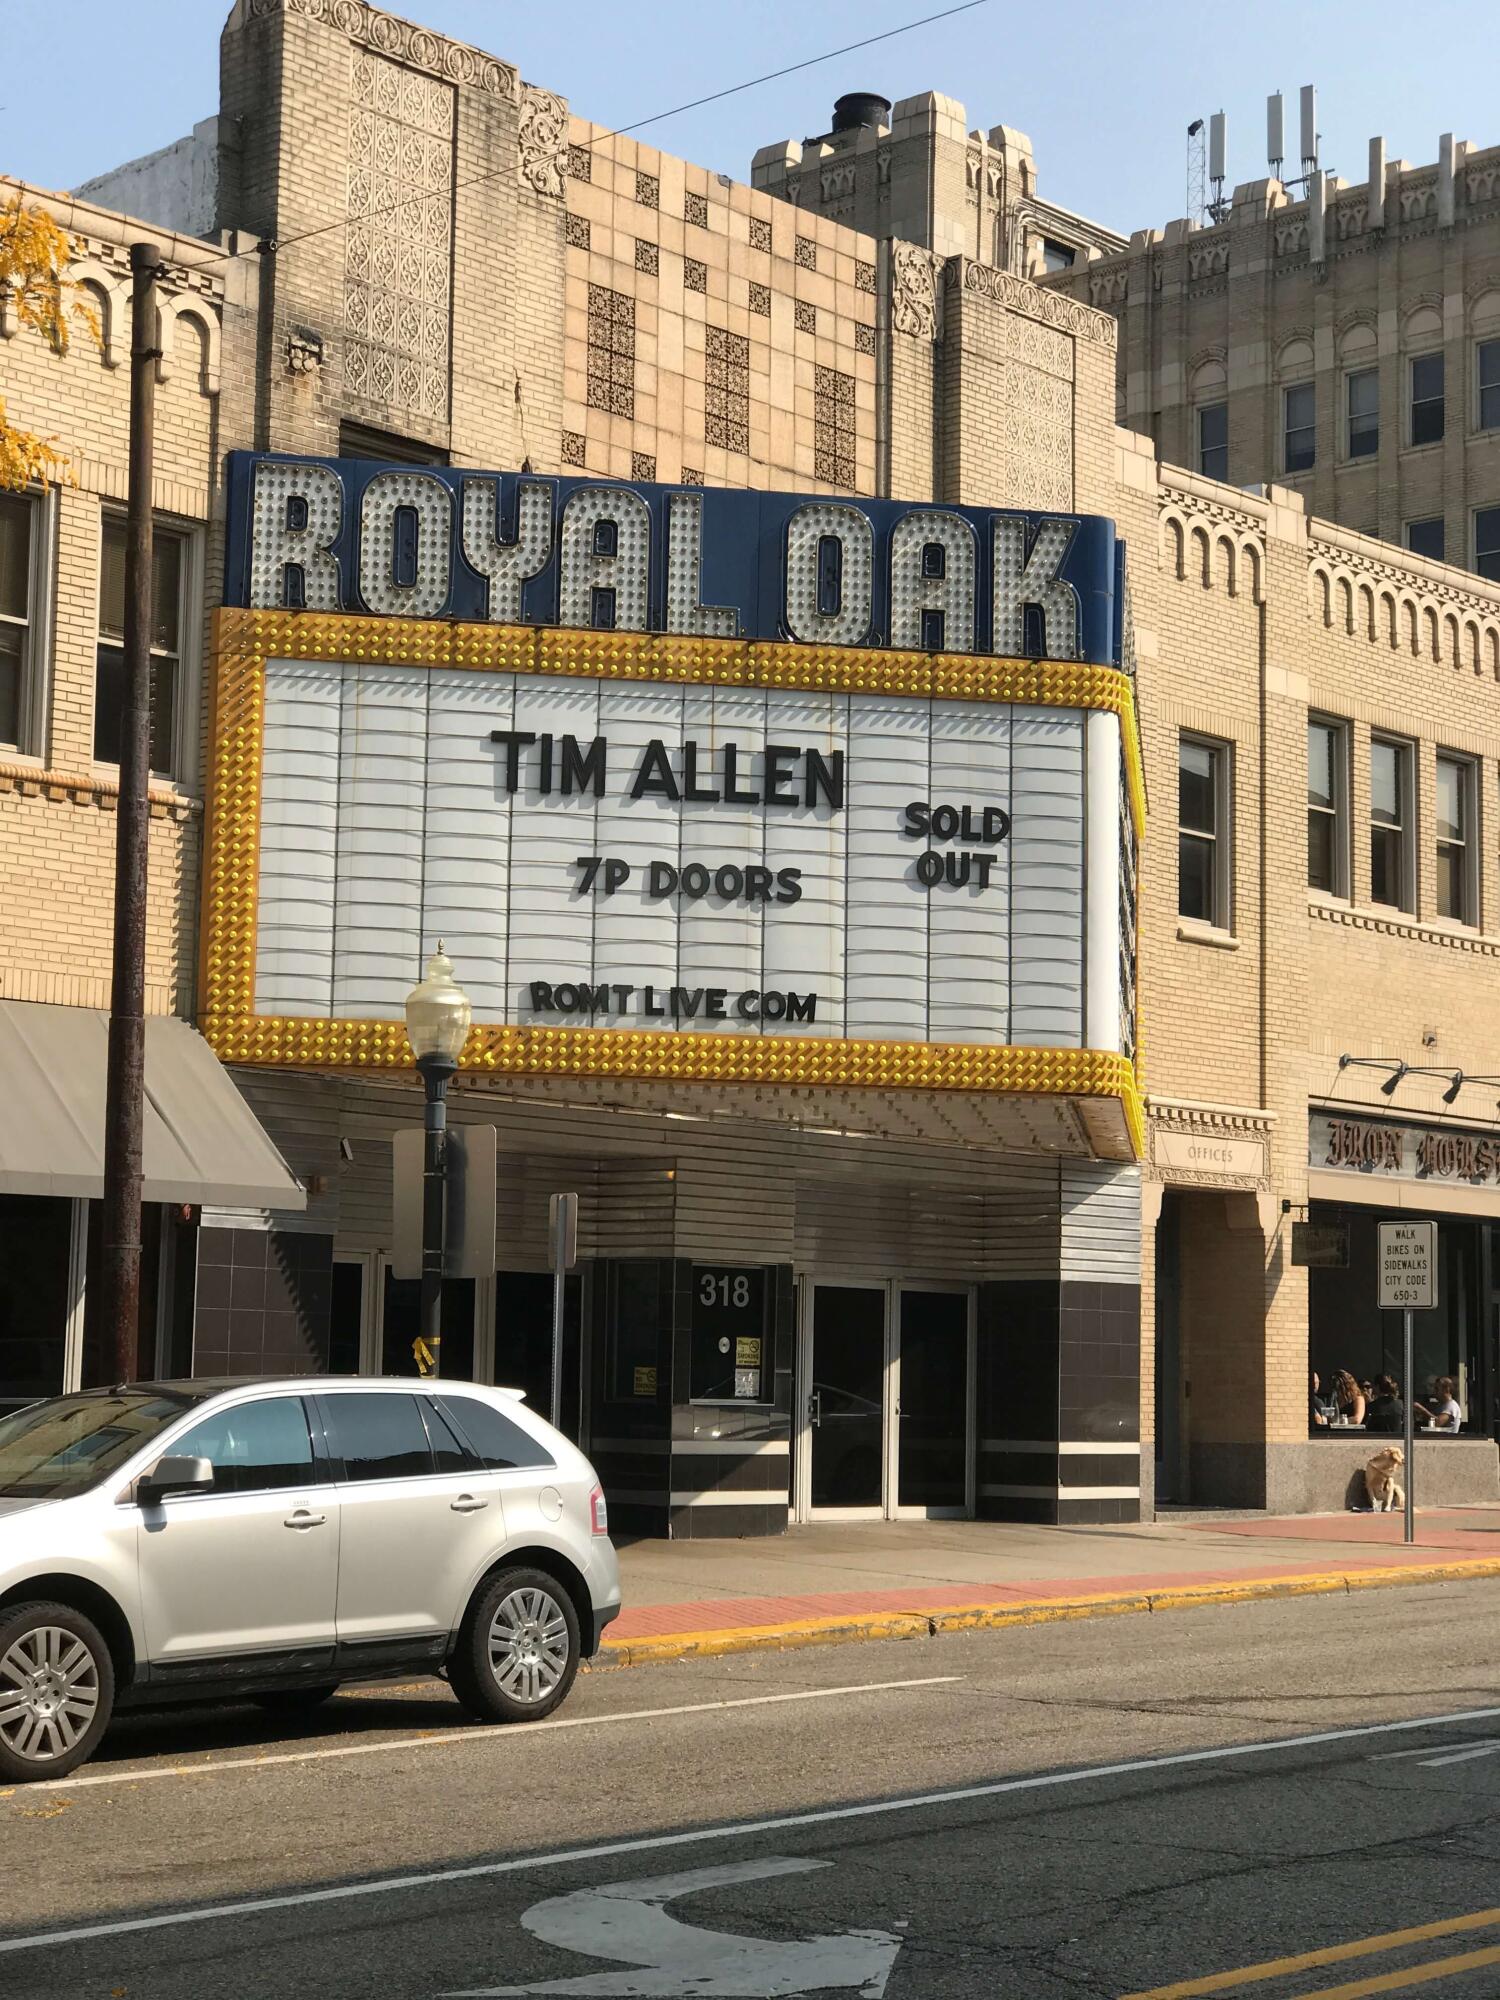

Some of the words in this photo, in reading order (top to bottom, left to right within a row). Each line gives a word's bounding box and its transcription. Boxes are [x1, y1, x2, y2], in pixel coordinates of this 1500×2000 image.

[249, 461, 738, 637] ROYAL
[783, 502, 1083, 660] OAK
[491, 730, 606, 798] TIM
[630, 739, 844, 809] ALLEN
[905, 802, 1009, 843] SOLD
[577, 857, 630, 895] 7P
[649, 860, 802, 902] DOORS
[917, 851, 997, 889] OUT
[1187, 1145, 1233, 1162] OFFICES
[1395, 1229, 1416, 1240] WALK
[1386, 1244, 1409, 1255] BIKES
[1413, 1244, 1425, 1255] ON
[1384, 1260, 1428, 1270] SIDEWALKS
[699, 1273, 750, 1308] 318
[1385, 1275, 1402, 1286] CITY
[1406, 1275, 1427, 1286] CODE
[1393, 1290, 1418, 1301] 650-3
